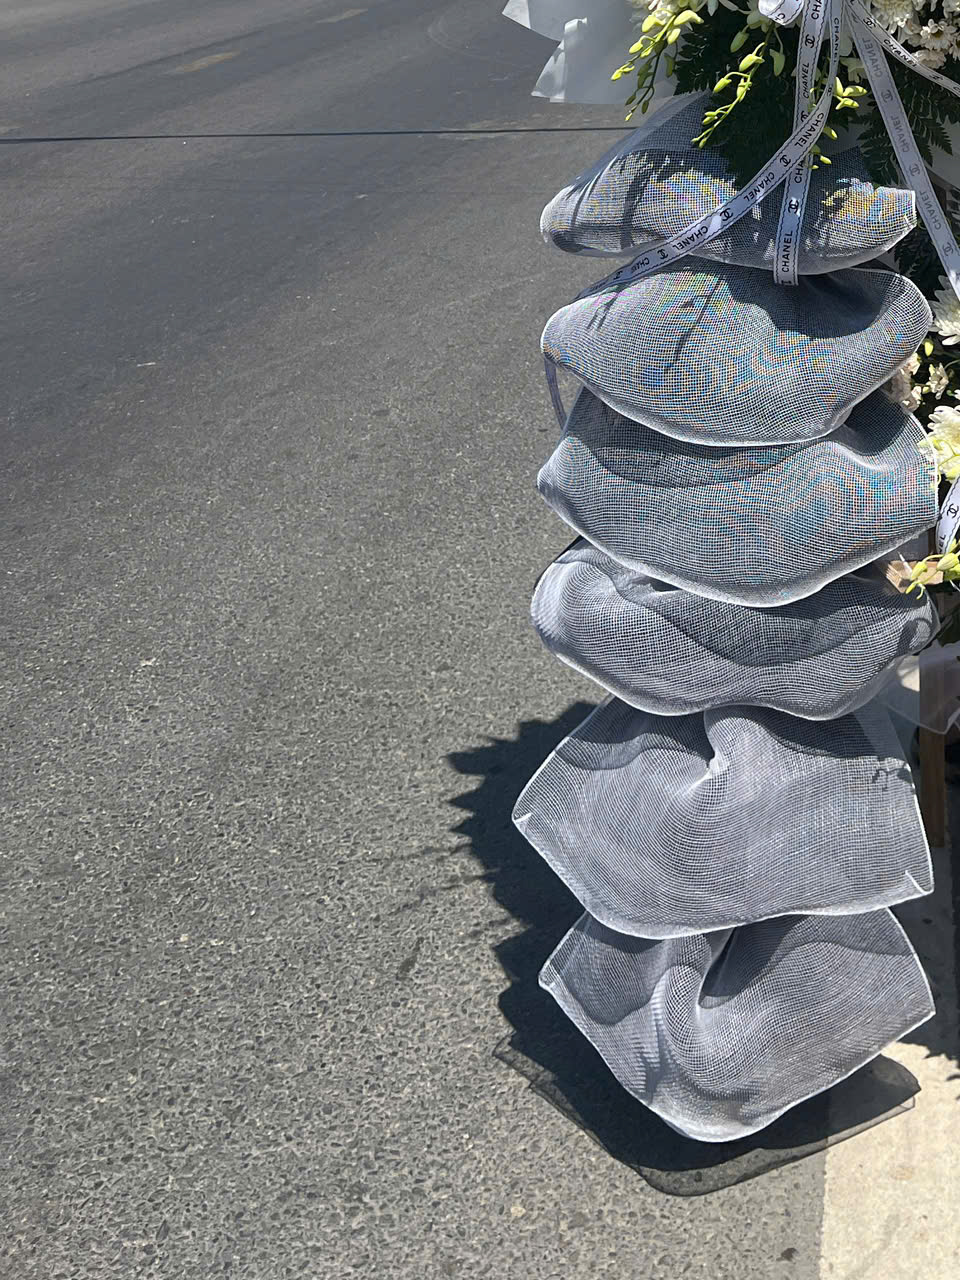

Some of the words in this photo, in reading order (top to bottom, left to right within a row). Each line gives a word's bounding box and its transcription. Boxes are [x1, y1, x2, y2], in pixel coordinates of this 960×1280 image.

[883, 38, 919, 69] CHANEL
[802, 62, 810, 99] CHANEL
[795, 111, 825, 149] CHANEL
[743, 171, 776, 202] CHANEL
[672, 226, 709, 252] CHANEL
[781, 230, 794, 273] CHANEL
